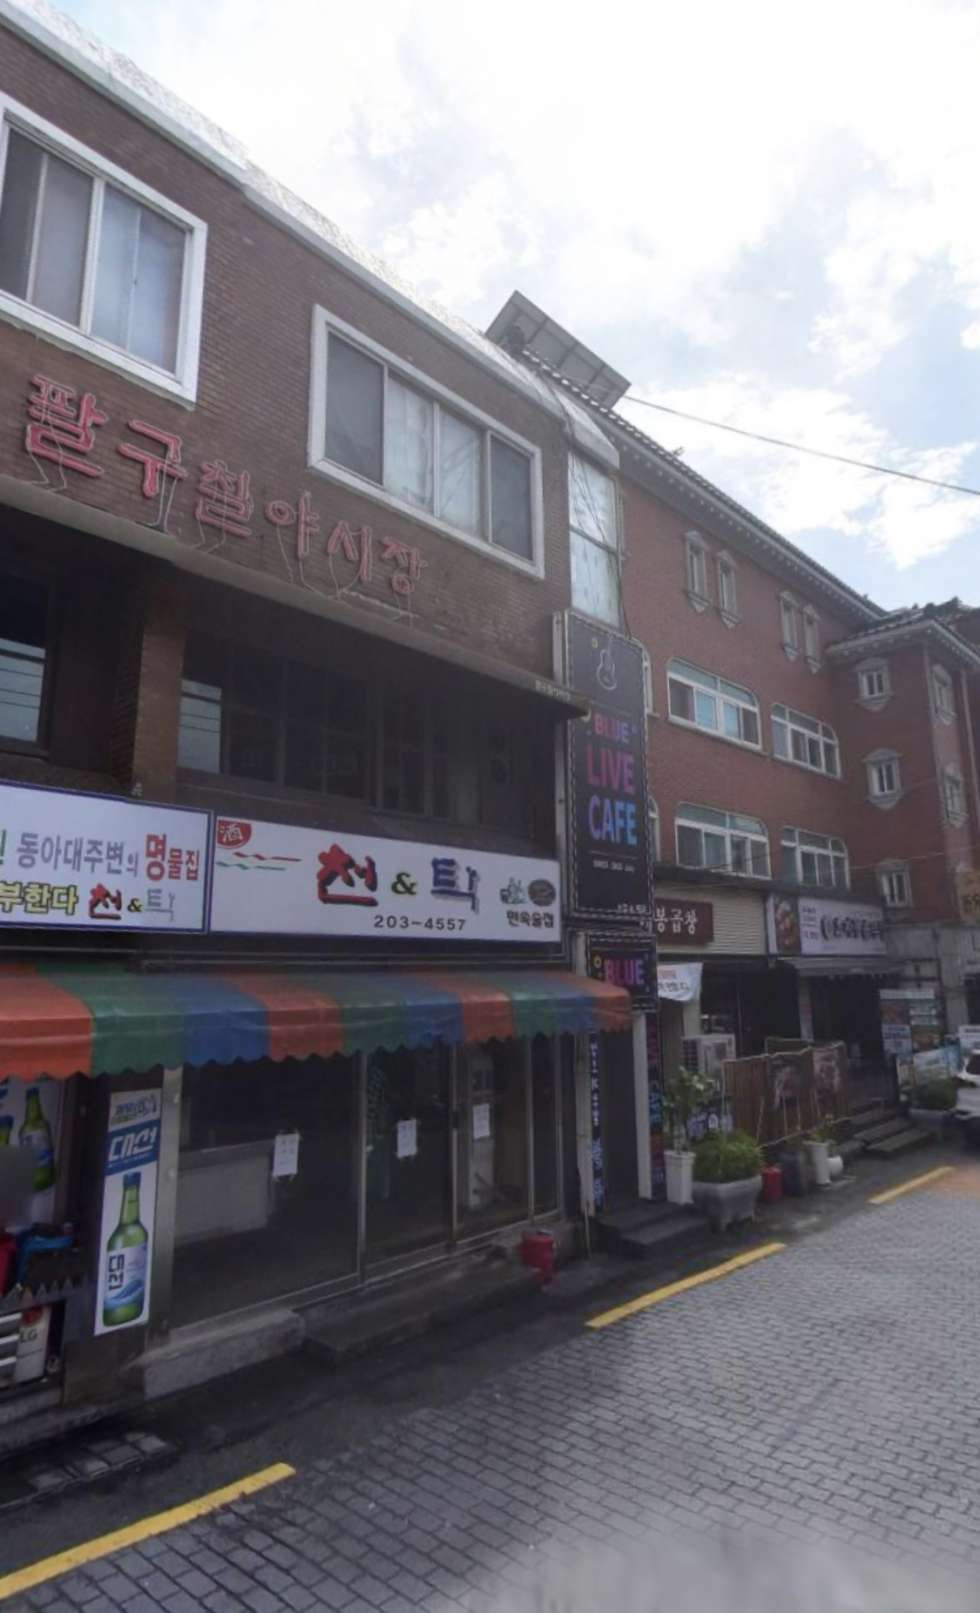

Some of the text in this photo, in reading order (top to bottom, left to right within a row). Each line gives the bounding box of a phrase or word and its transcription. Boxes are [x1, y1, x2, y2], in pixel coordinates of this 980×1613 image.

[592, 711, 630, 744] BLUE
[585, 746, 636, 796] LIVE
[588, 794, 638, 846] CAFE
[17, 831, 139, 878] 동아대주변의
[145, 831, 200, 882] 명물집
[373, 914, 467, 932] 203-4557
[604, 958, 645, 985] BLUE
